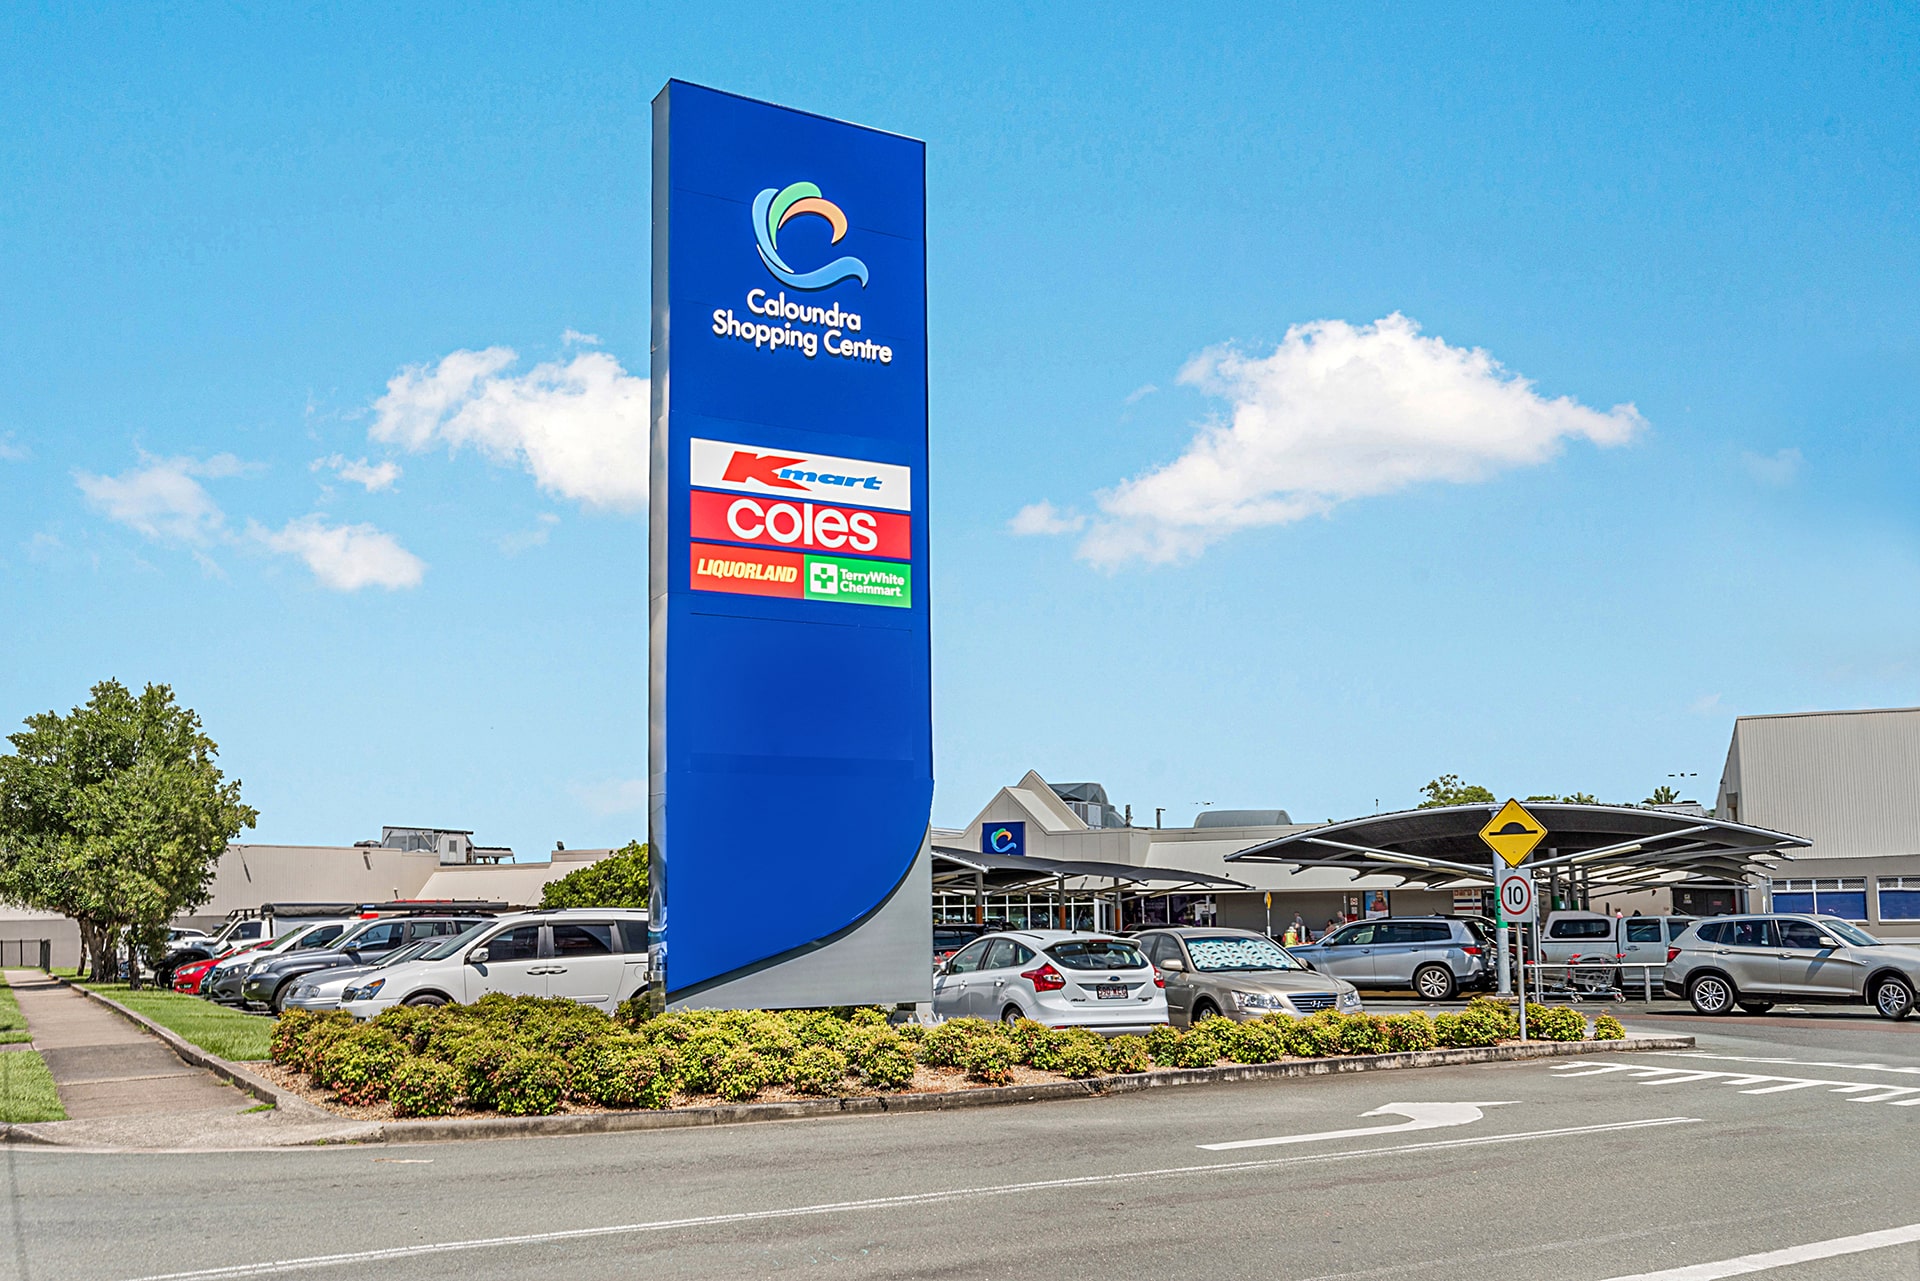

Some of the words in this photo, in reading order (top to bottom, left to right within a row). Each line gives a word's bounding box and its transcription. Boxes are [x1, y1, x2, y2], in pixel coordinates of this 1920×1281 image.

[746, 288, 861, 331] Caloundra
[712, 309, 818, 357] Shopping
[823, 330, 893, 363] Centre
[722, 450, 883, 491] Kmart
[727, 498, 878, 552] coles
[697, 558, 798, 583] LIQUORLAND
[839, 568, 905, 585] TerryWhite
[1507, 886, 1524, 905] 10
